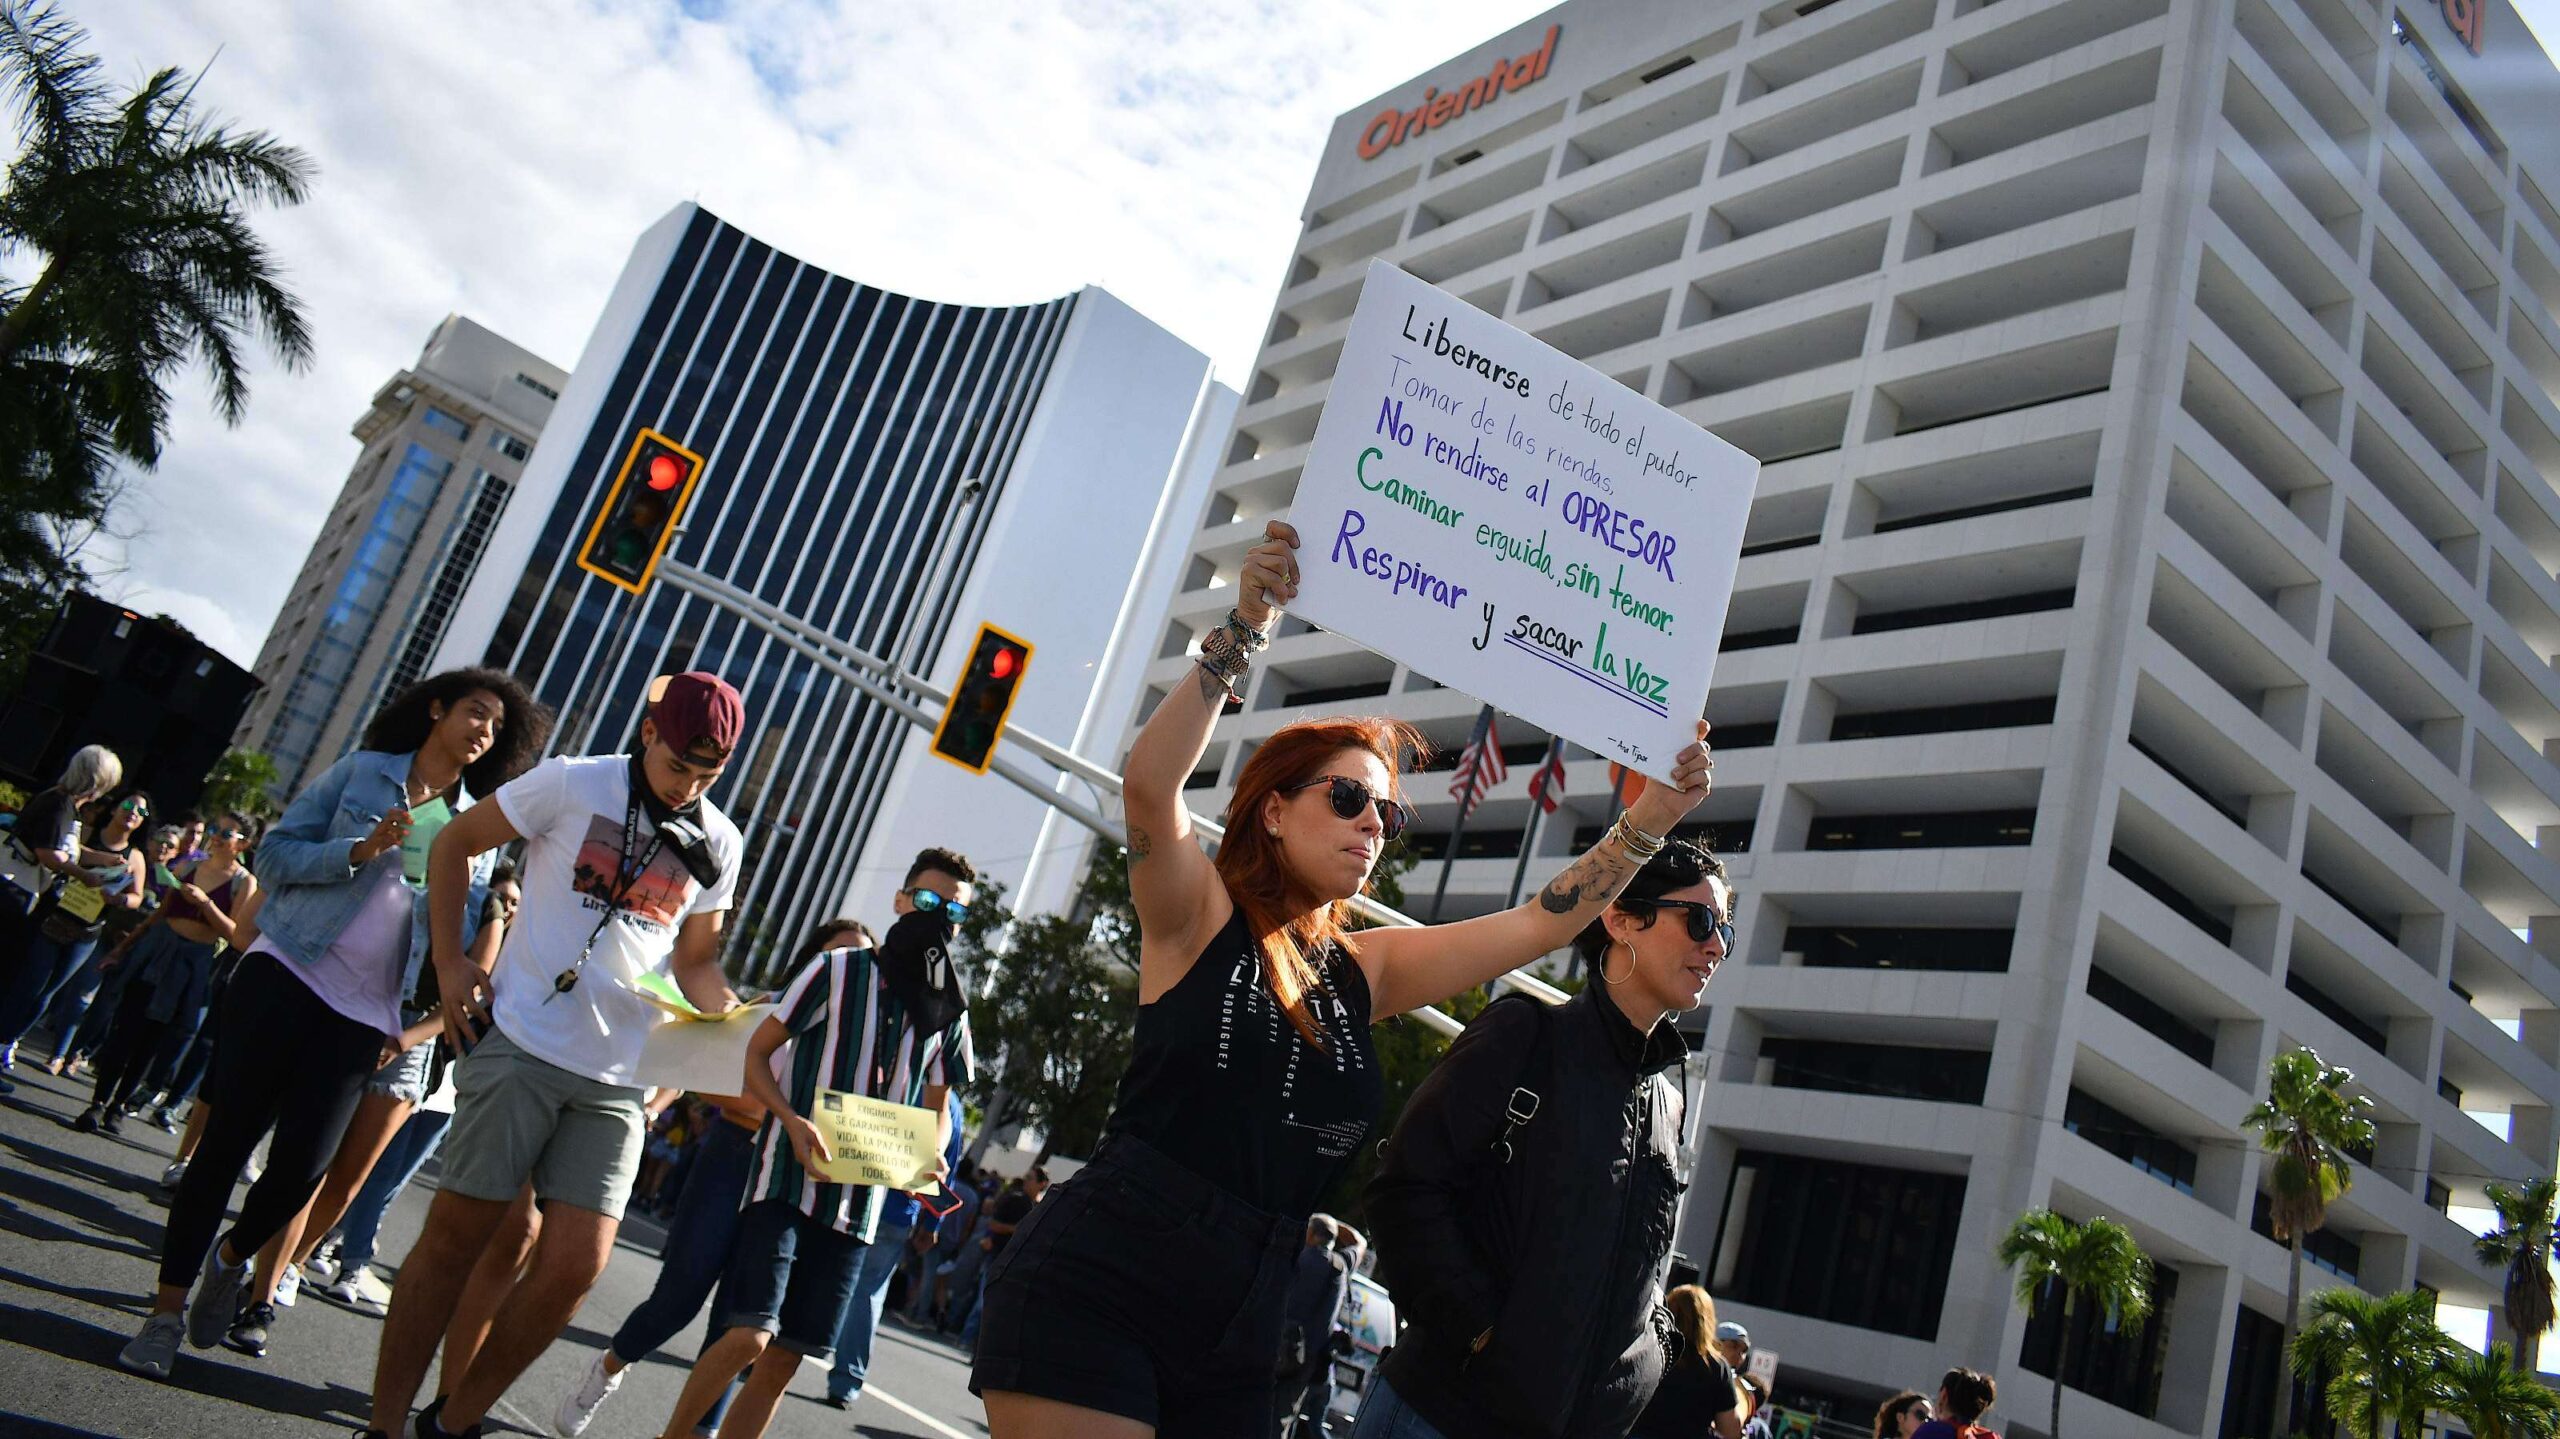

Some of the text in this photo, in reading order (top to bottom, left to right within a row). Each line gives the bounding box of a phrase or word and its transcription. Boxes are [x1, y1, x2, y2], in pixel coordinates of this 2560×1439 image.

[1357, 23, 1562, 161] Oriental
[1391, 354, 1464, 416] Tomar
[1470, 397, 1495, 435] de
[1506, 414, 1536, 455] las
[1402, 304, 1698, 492] Liberarse de todo el pudor.
[1376, 396, 1414, 447] No
[1424, 433, 1508, 492] rendirse
[1525, 478, 1549, 507] al
[1331, 509, 1468, 609] Respirar
[1472, 602, 1495, 651] y
[1511, 614, 1583, 659] sacar
[1592, 621, 1617, 677] la
[1357, 447, 1465, 528] Caminar
[1609, 564, 1674, 636] temor.
[625, 808, 638, 857] SUBARU
[838, 1147, 897, 1168] DESARROLLO
[863, 1136, 874, 1146] LA
[904, 1128, 915, 1140] LA
